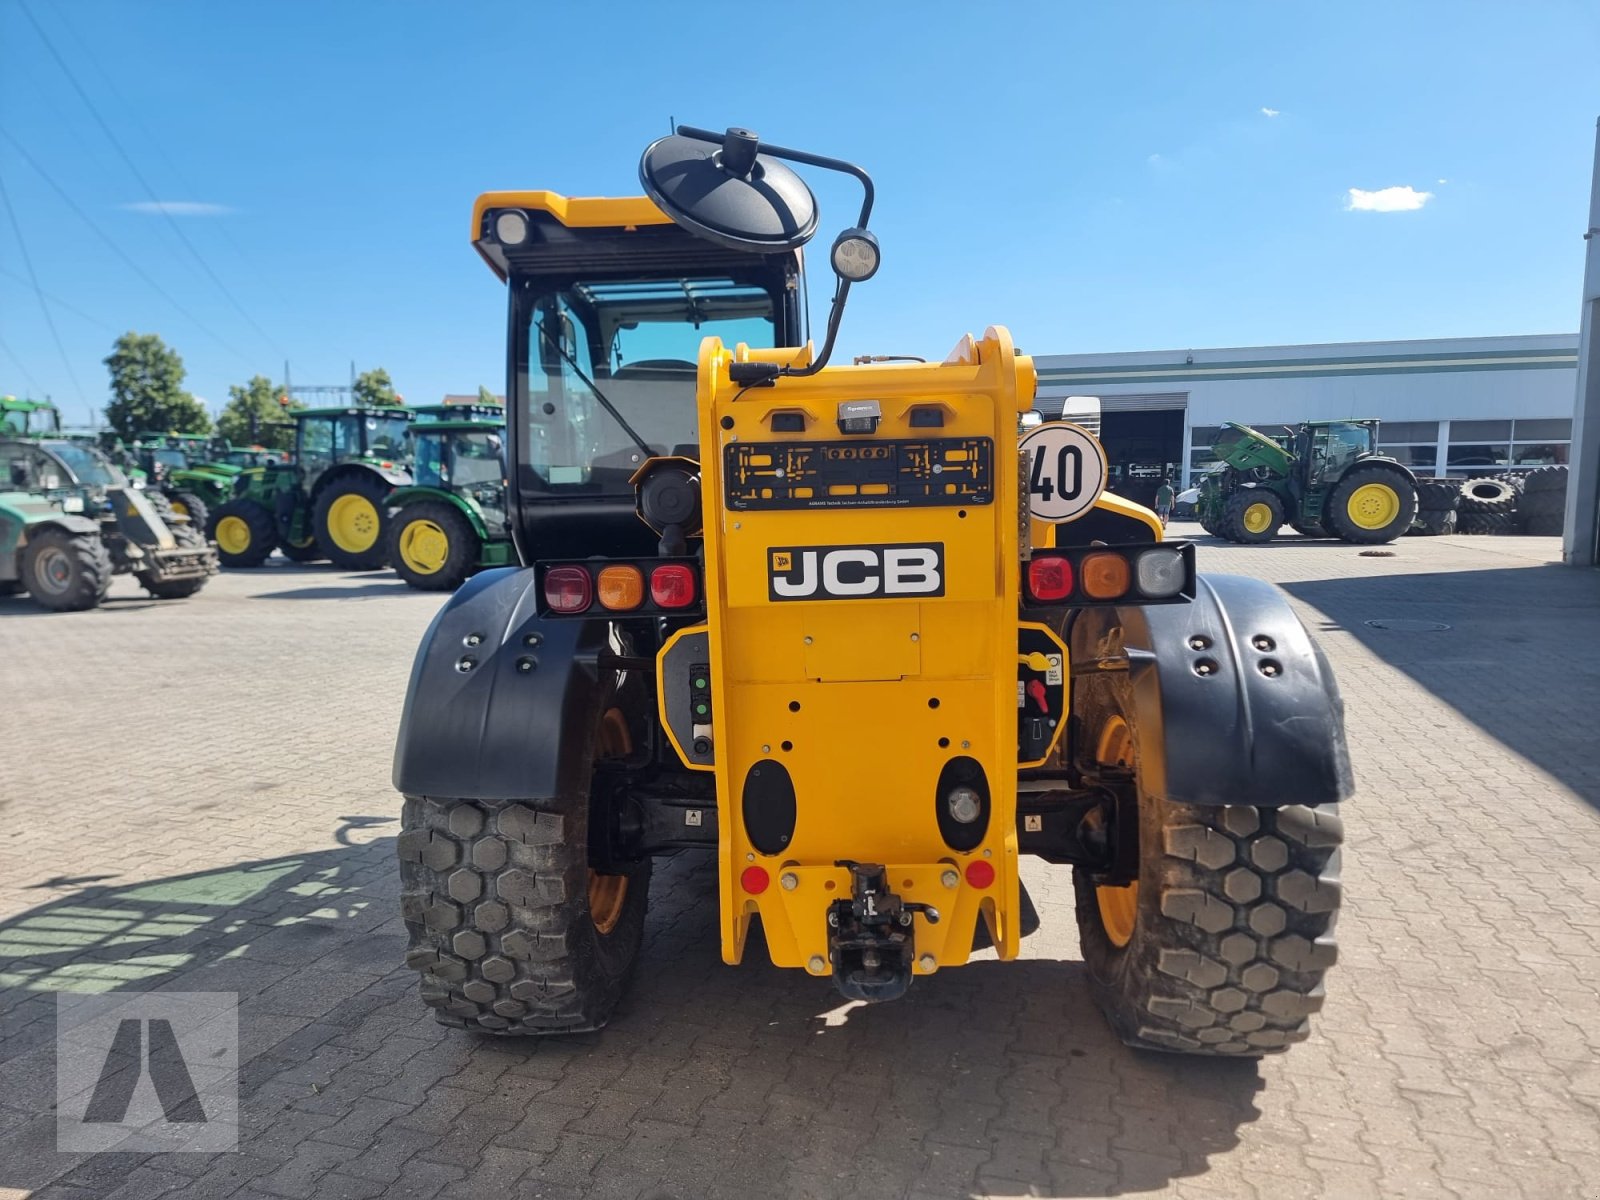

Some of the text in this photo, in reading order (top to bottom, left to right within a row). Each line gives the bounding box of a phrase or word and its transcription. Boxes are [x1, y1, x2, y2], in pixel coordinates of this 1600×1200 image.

[1030, 444, 1083, 501] 40
[773, 548, 941, 597] JCB
[775, 555, 789, 567] JCB
